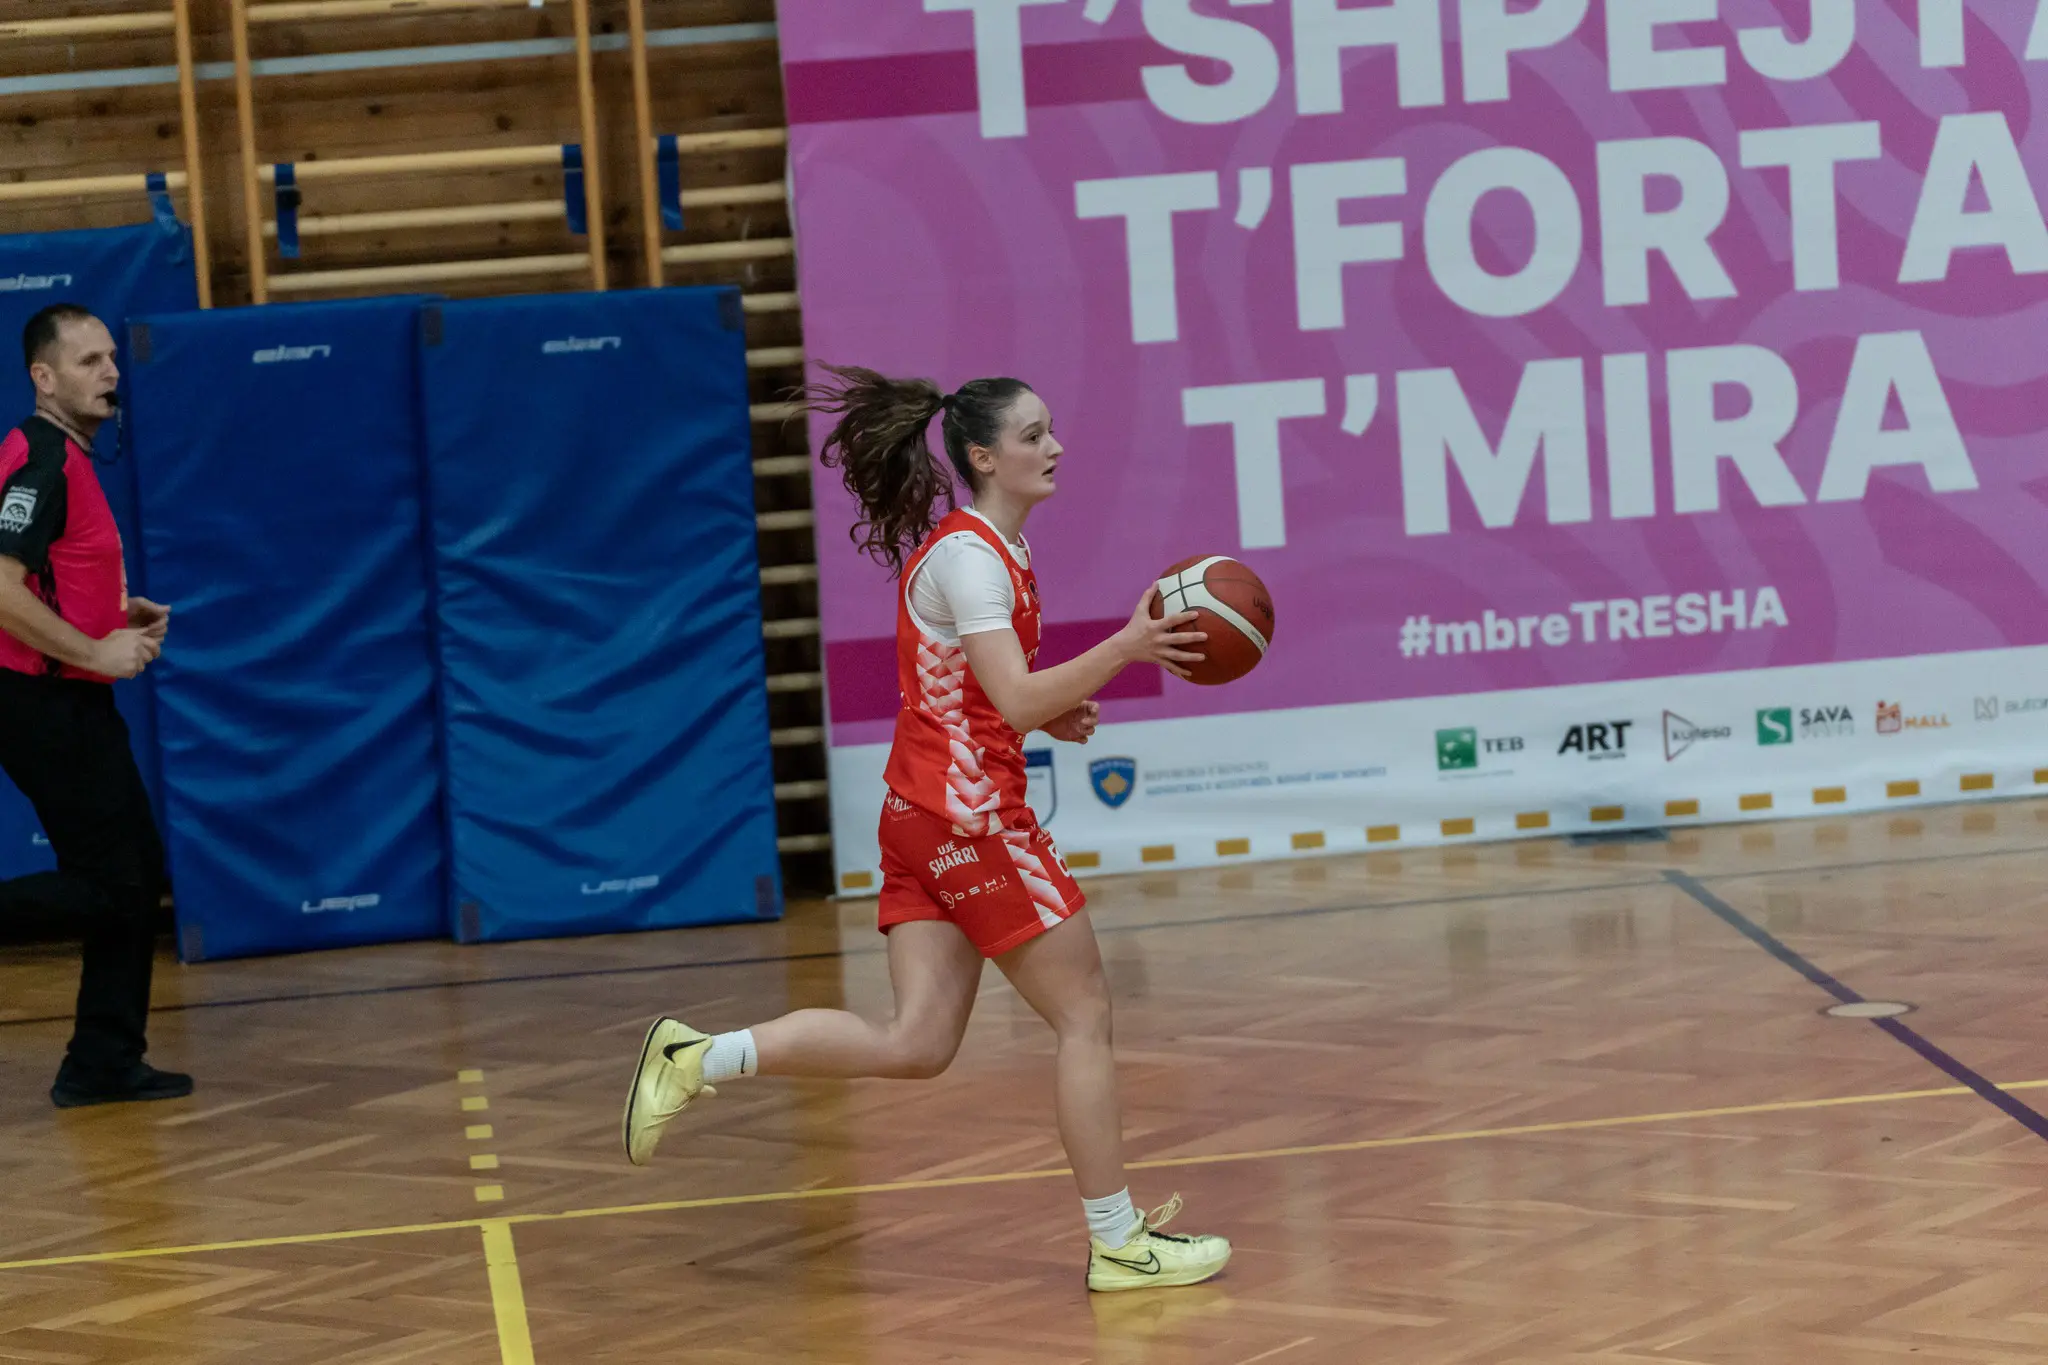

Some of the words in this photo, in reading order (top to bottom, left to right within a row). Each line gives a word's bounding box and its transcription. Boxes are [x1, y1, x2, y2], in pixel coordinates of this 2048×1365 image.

[1074, 111, 2048, 344] T'FORTA
[1181, 330, 1979, 550] T'MIRA
[1399, 586, 1788, 657] #mbreTRESHA
[1800, 705, 1854, 726] SAVA
[1482, 736, 1525, 754] TEB
[1557, 719, 1634, 757] ART
[928, 845, 980, 880] SHARRI
